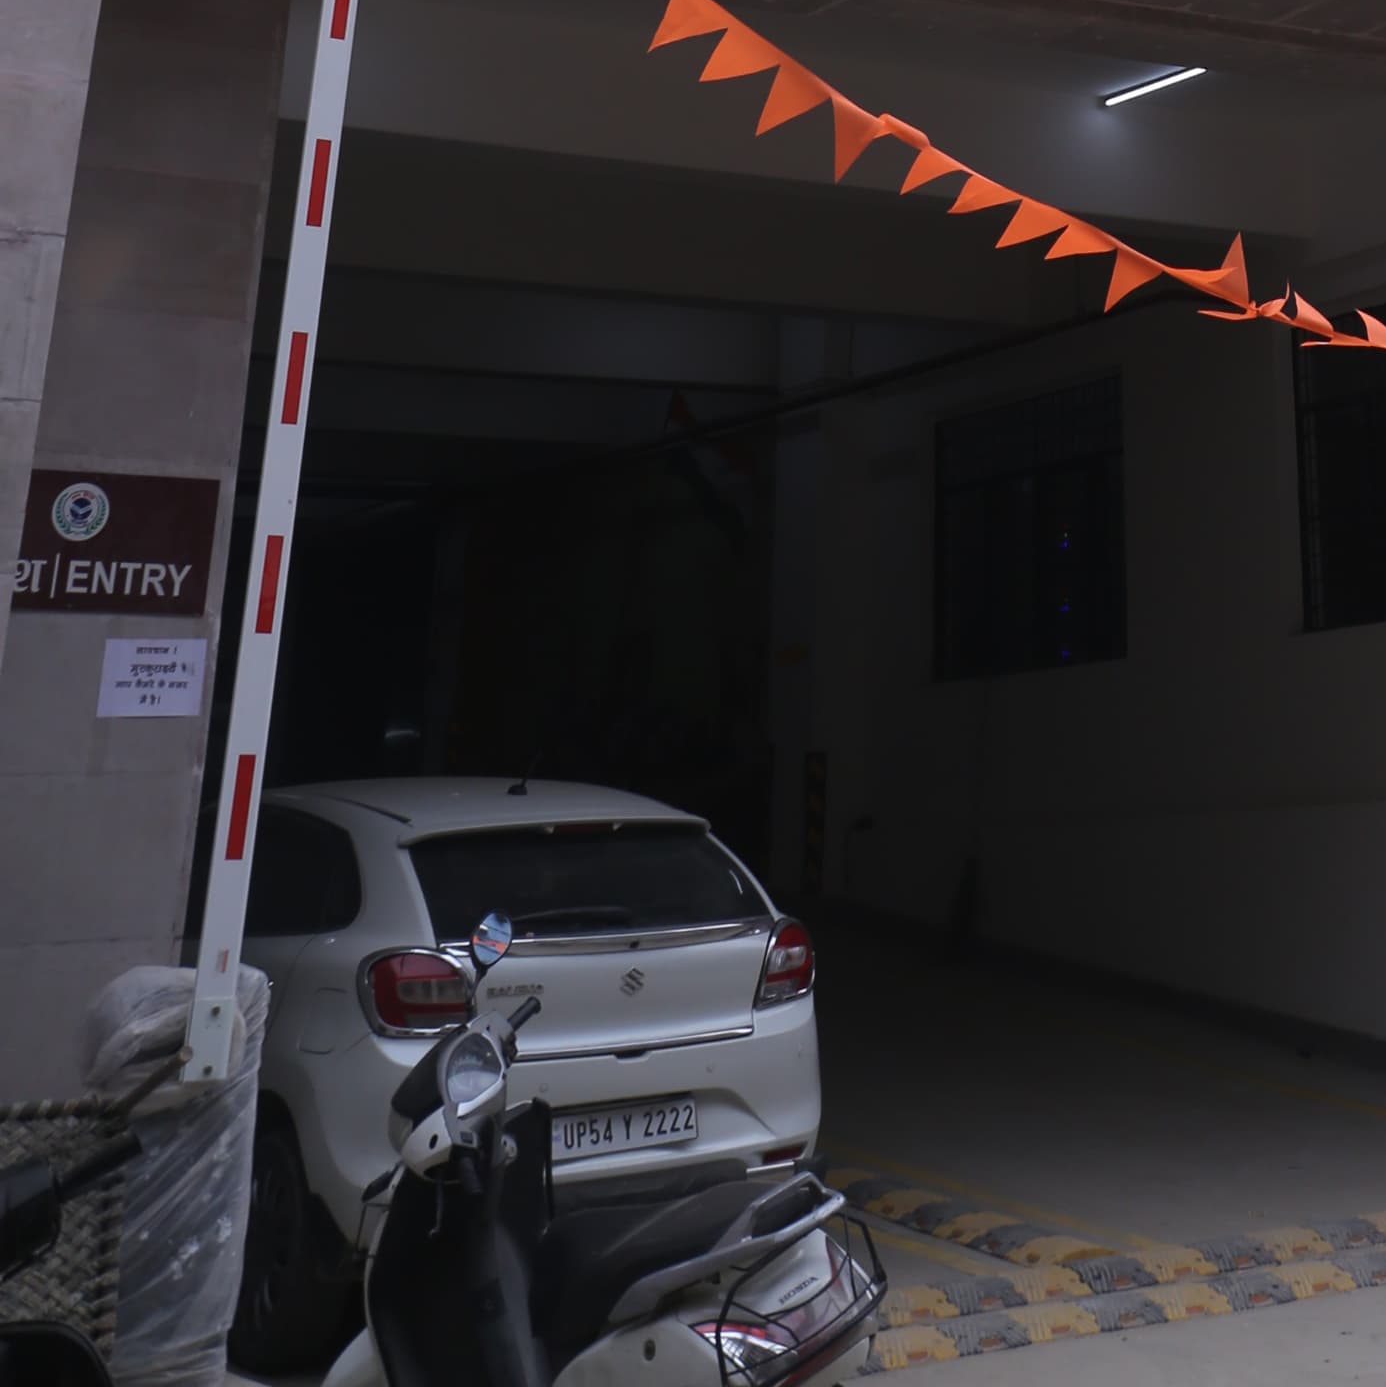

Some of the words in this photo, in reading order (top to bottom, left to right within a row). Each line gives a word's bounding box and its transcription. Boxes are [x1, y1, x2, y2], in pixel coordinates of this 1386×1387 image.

[65, 559, 193, 598] ENTRY
[563, 1117, 613, 1149] UP54
[623, 1114, 632, 1140] Y
[643, 1104, 695, 1138] 2222
